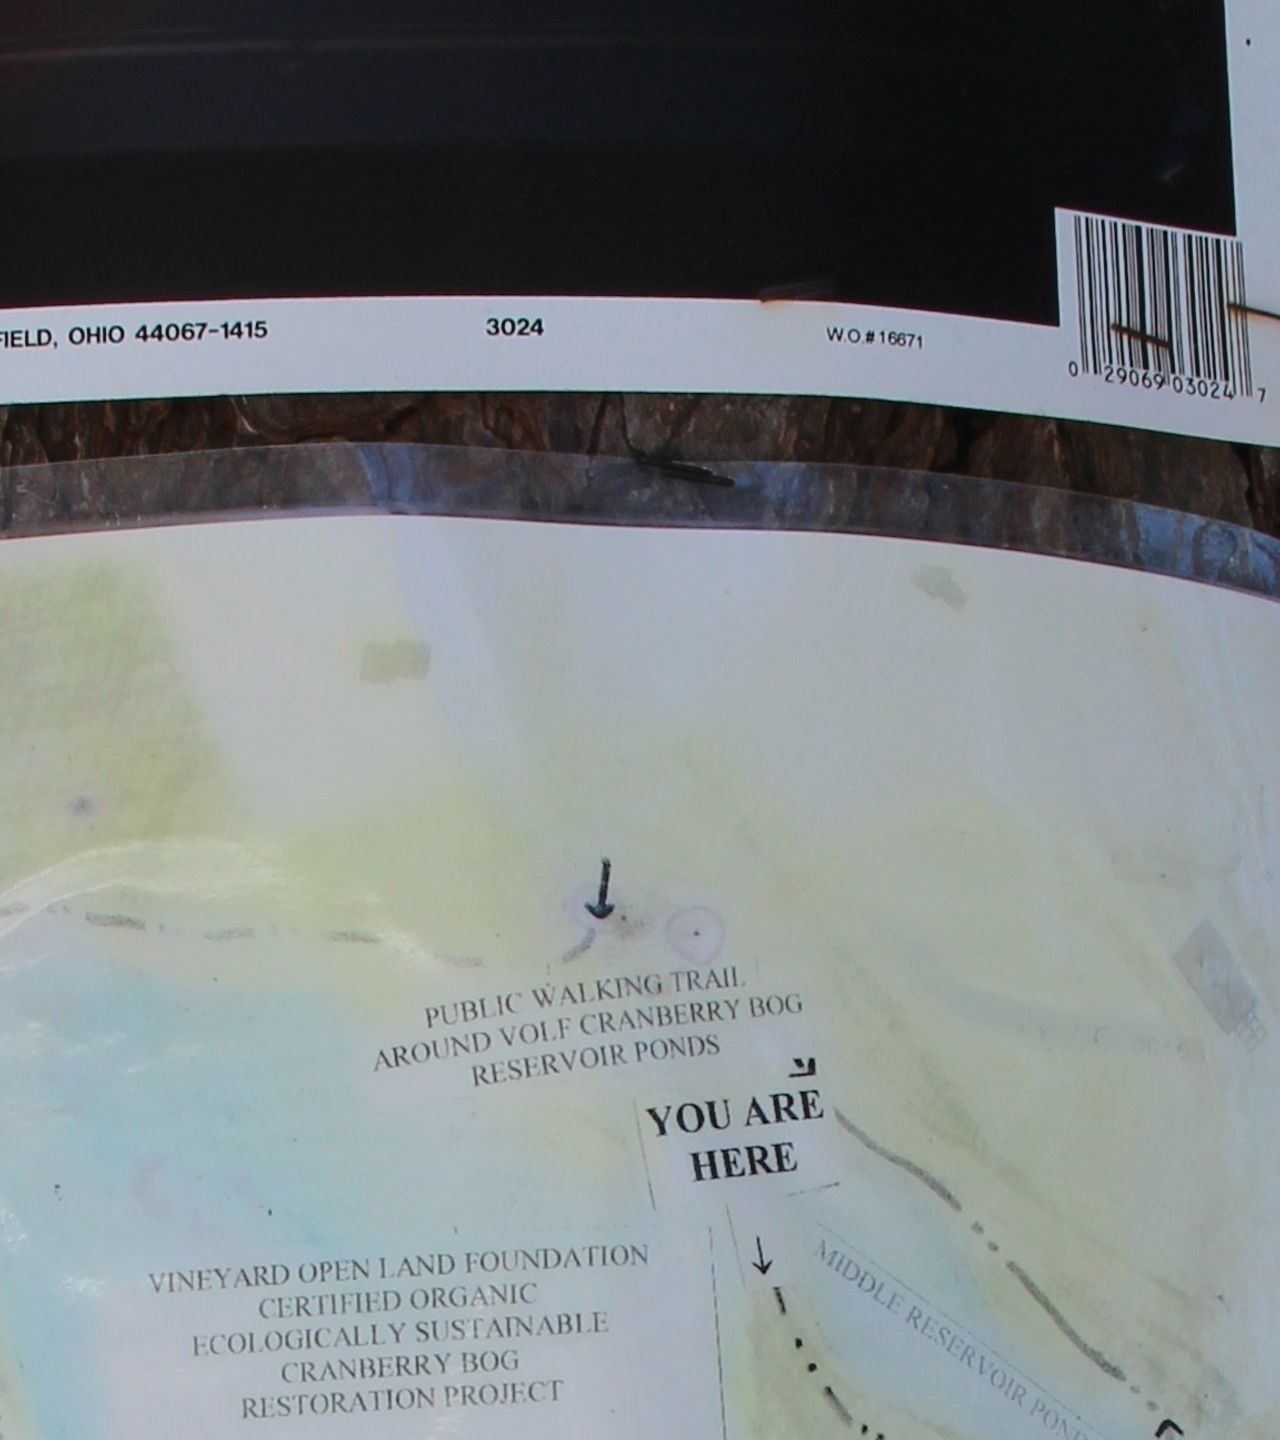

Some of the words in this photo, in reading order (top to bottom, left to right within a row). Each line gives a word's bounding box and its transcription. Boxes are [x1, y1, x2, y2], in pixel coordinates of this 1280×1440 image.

[68, 325, 125, 346] OHIO
[135, 321, 268, 342] 44067-1415
[486, 317, 545, 337] 3024
[425, 992, 521, 1028] PUBLIC
[533, 972, 663, 1008] WALKING
[670, 966, 745, 994] TRAIL
[373, 1032, 492, 1072] AROUND
[503, 1017, 571, 1047] VOLF
[580, 999, 740, 1037] CRANBERRY
[750, 994, 803, 1019] BOG
[471, 1045, 624, 1087] RESERVOIR
[635, 1034, 721, 1061] PONDS
[646, 1100, 731, 1136] YOU
[744, 1090, 824, 1127] ARE
[689, 1142, 798, 1182] HERE
[149, 1264, 290, 1295] VINEYARD
[299, 1259, 370, 1283] OPEN
[379, 1254, 455, 1279] LAND
[465, 1244, 648, 1274] FOUNDATION
[258, 1291, 402, 1320] CERTIFIED
[410, 1283, 537, 1311] ORGANIC
[814, 1239, 905, 1315] MIDDLE
[906, 1304, 1029, 1407] RESERVOIR
[192, 1323, 406, 1356] ECOLOGICALLY
[416, 1312, 608, 1343] SUSTAINABLE
[281, 1353, 452, 1383] CRANBERRY
[462, 1349, 519, 1373] BOG
[241, 1387, 435, 1419] RESTORATION
[445, 1380, 564, 1405] PROJECT
